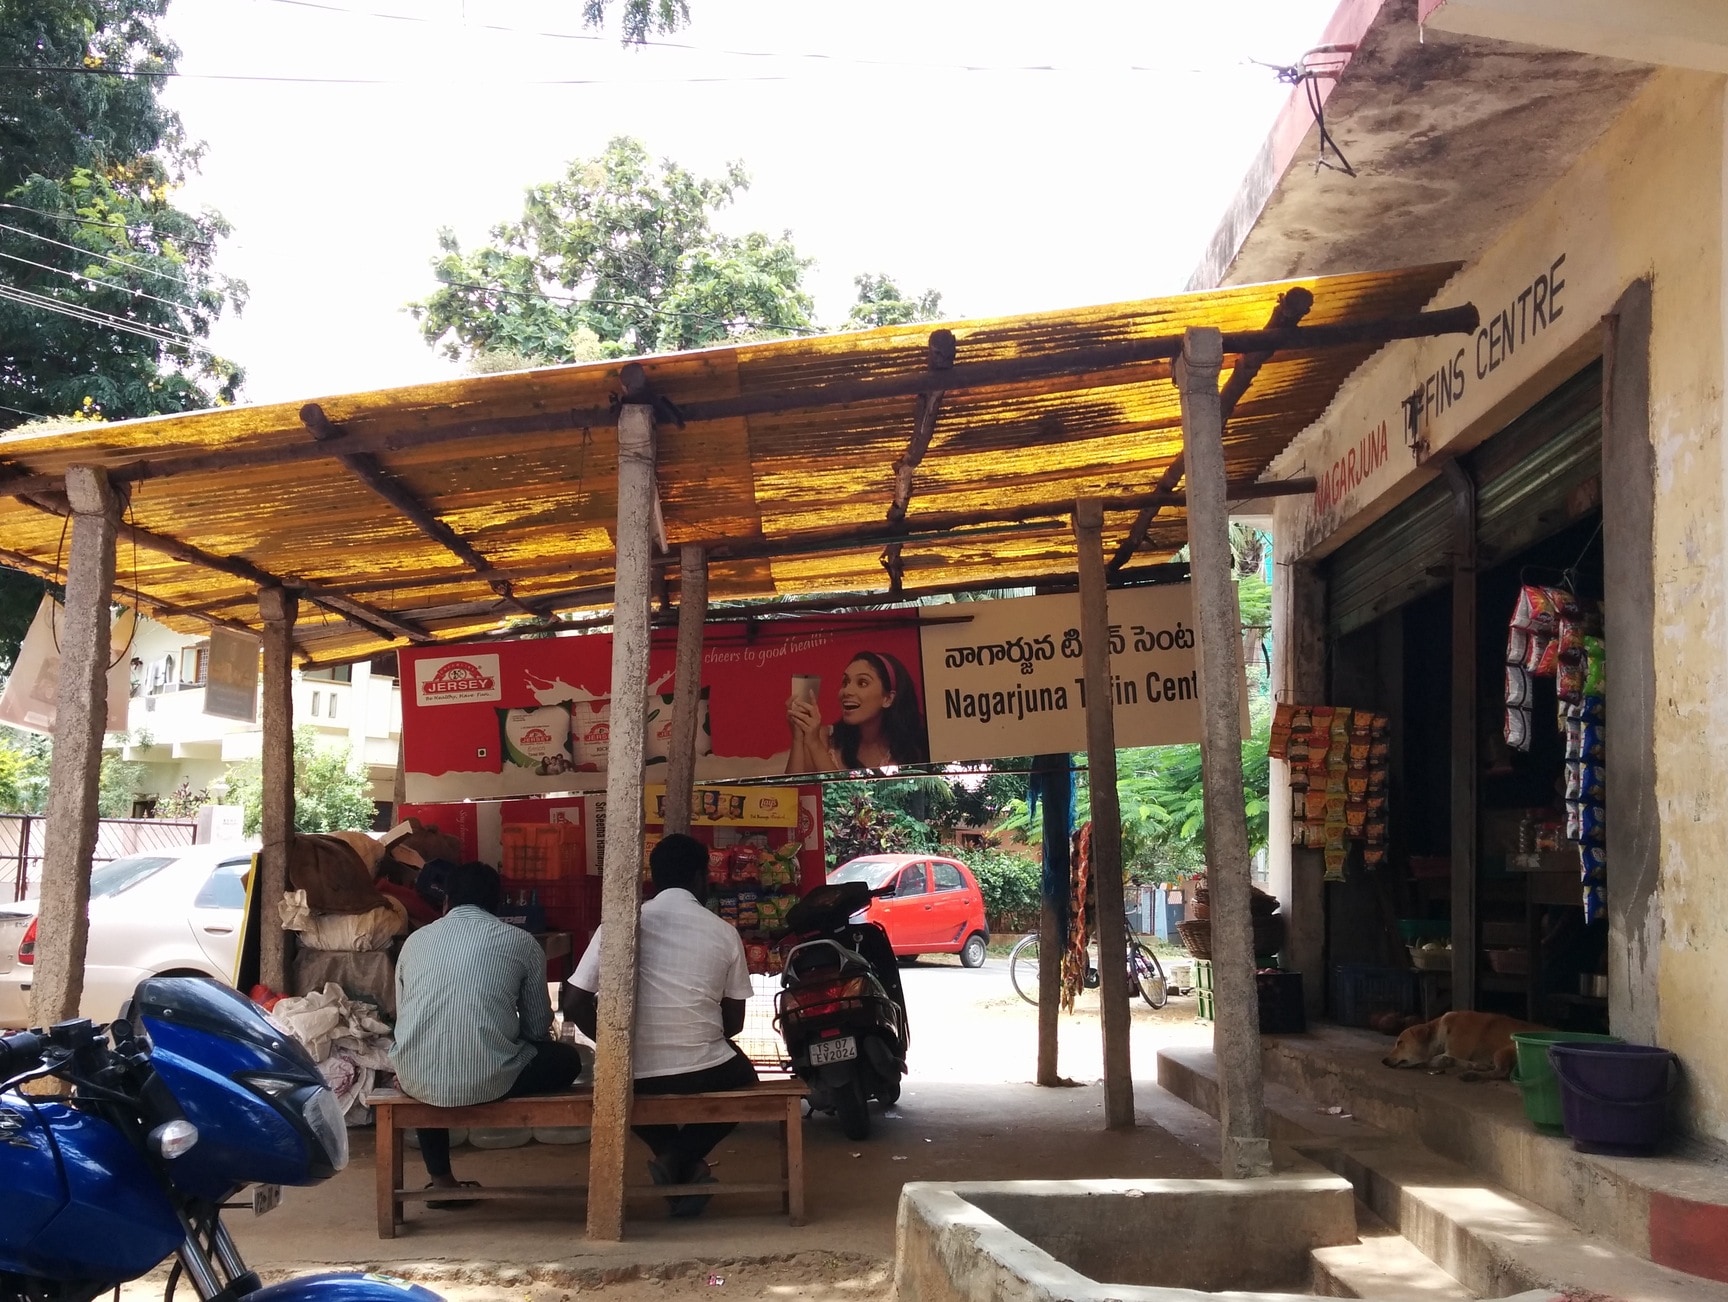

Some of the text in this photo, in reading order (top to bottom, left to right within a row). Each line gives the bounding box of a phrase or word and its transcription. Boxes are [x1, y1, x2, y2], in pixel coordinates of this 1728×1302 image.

[1315, 420, 1387, 517] NAGARJUNA
[1477, 253, 1566, 380] CENTRE
[704, 646, 741, 663] cheers
[744, 647, 755, 661] to
[757, 638, 787, 668] good
[945, 634, 1055, 675] నాగార్జున
[428, 679, 488, 693] JERSEY
[944, 670, 1199, 724] Nagarjuna Tin Cent
[595, 801, 607, 812] Sri
[816, 1047, 855, 1063] EV2024
[817, 1038, 847, 1053] TS 07
